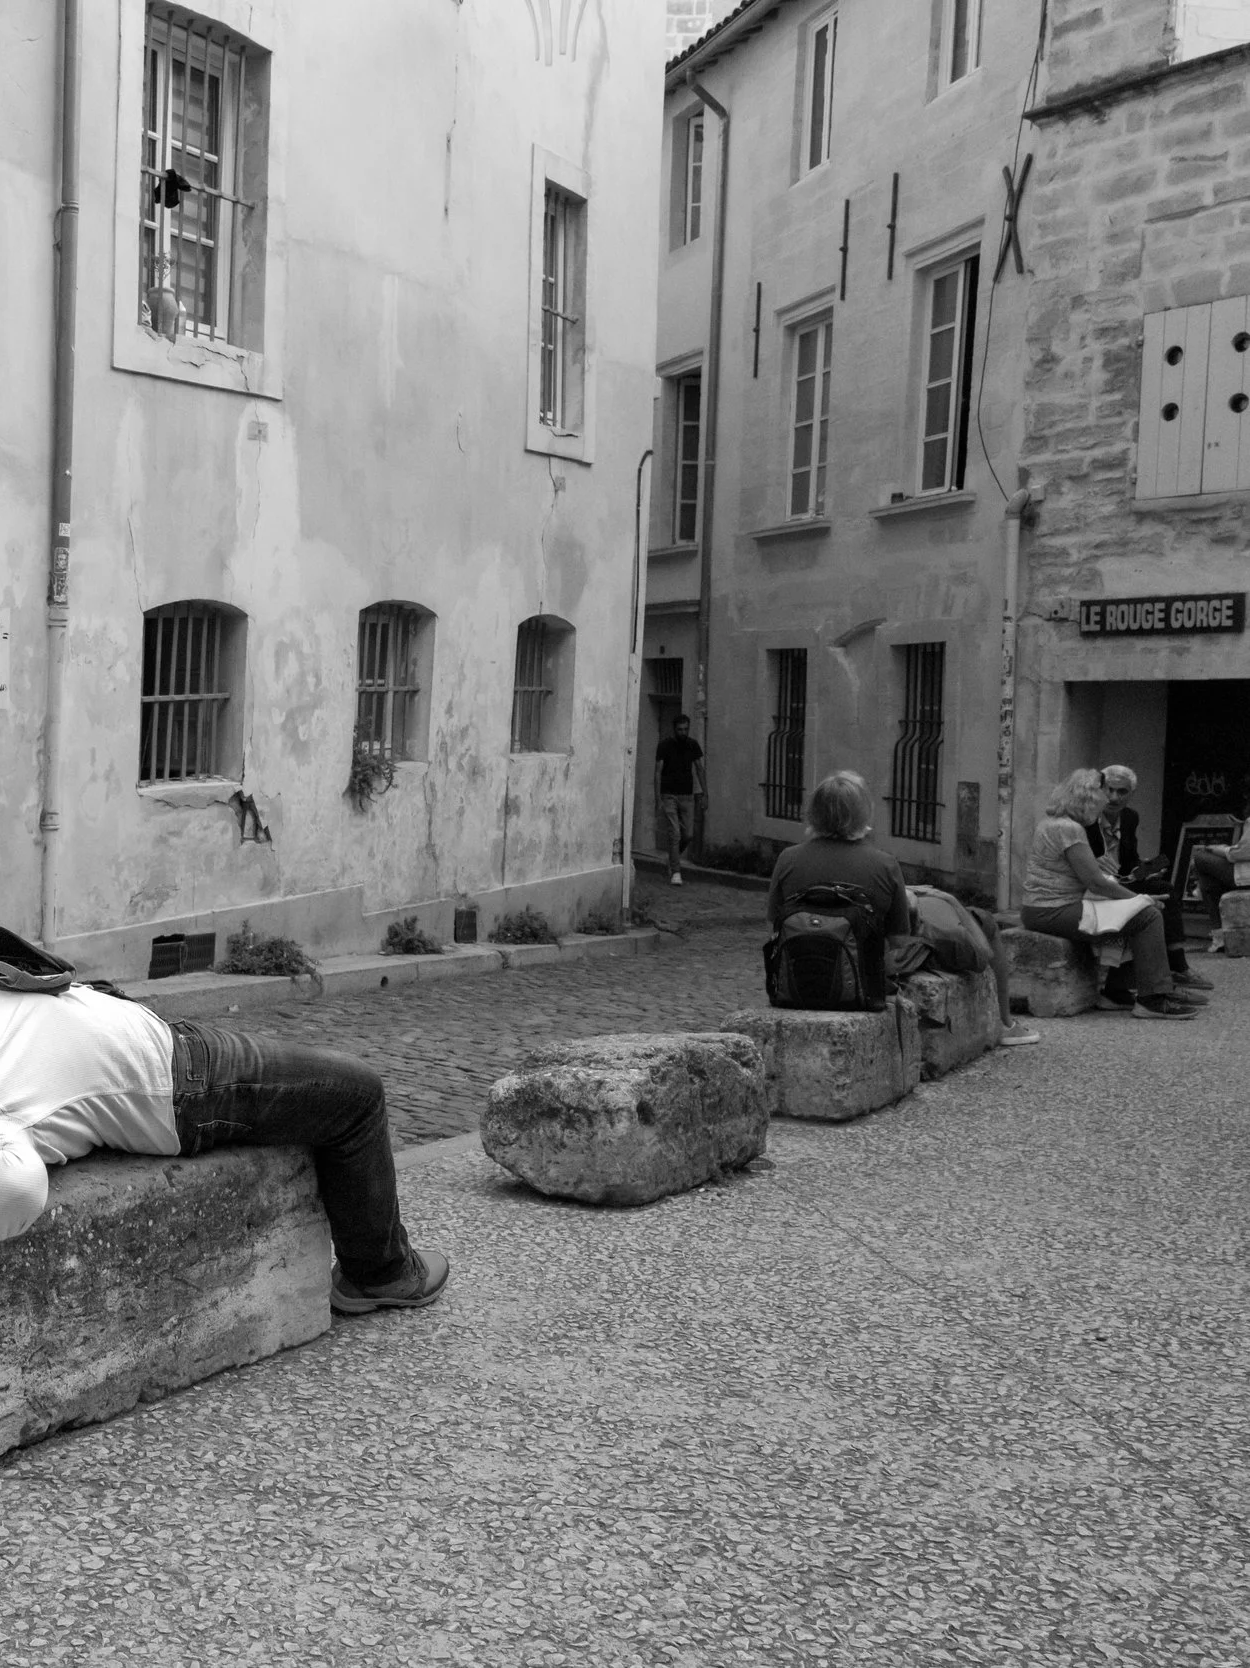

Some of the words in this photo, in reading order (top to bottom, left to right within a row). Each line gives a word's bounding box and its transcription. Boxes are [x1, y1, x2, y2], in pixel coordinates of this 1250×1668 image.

[1081, 605, 1101, 632] LE
[1106, 602, 1166, 630] ROUGE
[1170, 599, 1234, 628] GORGE
